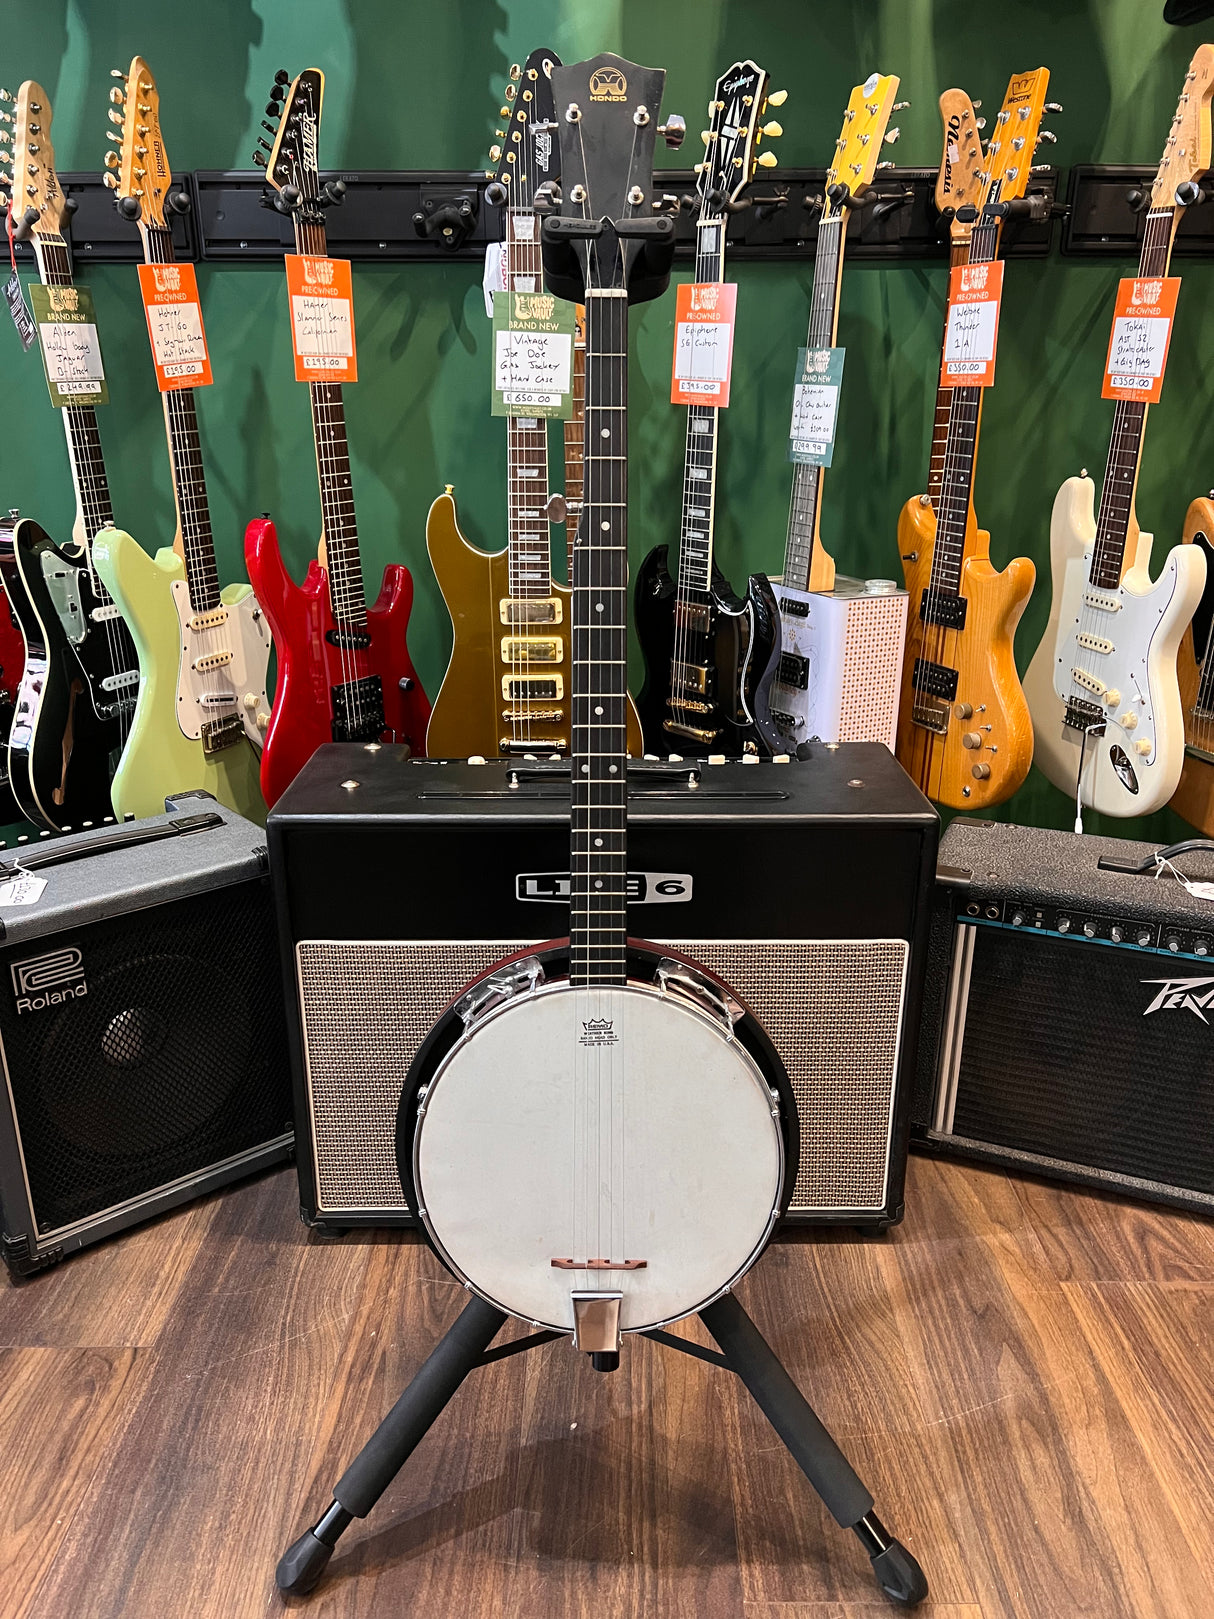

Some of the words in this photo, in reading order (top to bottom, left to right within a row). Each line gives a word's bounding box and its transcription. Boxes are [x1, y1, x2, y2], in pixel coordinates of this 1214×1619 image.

[722, 74, 755, 95] Epiphone
[303, 112, 317, 172] HAMER
[152, 141, 167, 178] HOHNER
[535, 149, 544, 167] GAS
[943, 115, 961, 195] Neesis
[528, 295, 555, 309] MUSIC
[47, 313, 71, 321] BRAND
[71, 313, 86, 321] NEW
[531, 308, 554, 321] VAULT
[1126, 307, 1162, 316] PRE-OWNED
[509, 320, 537, 330] BRAND
[539, 322, 560, 331] NEW
[514, 334, 549, 351] Vintage
[502, 348, 519, 358] Joe
[527, 348, 547, 358] Doe
[817, 375, 832, 383] NEW
[1113, 376, 1150, 388] £350.00
[526, 879, 639, 895] LIE
[655, 879, 686, 896] 6
[16, 981, 88, 1015] Roland
